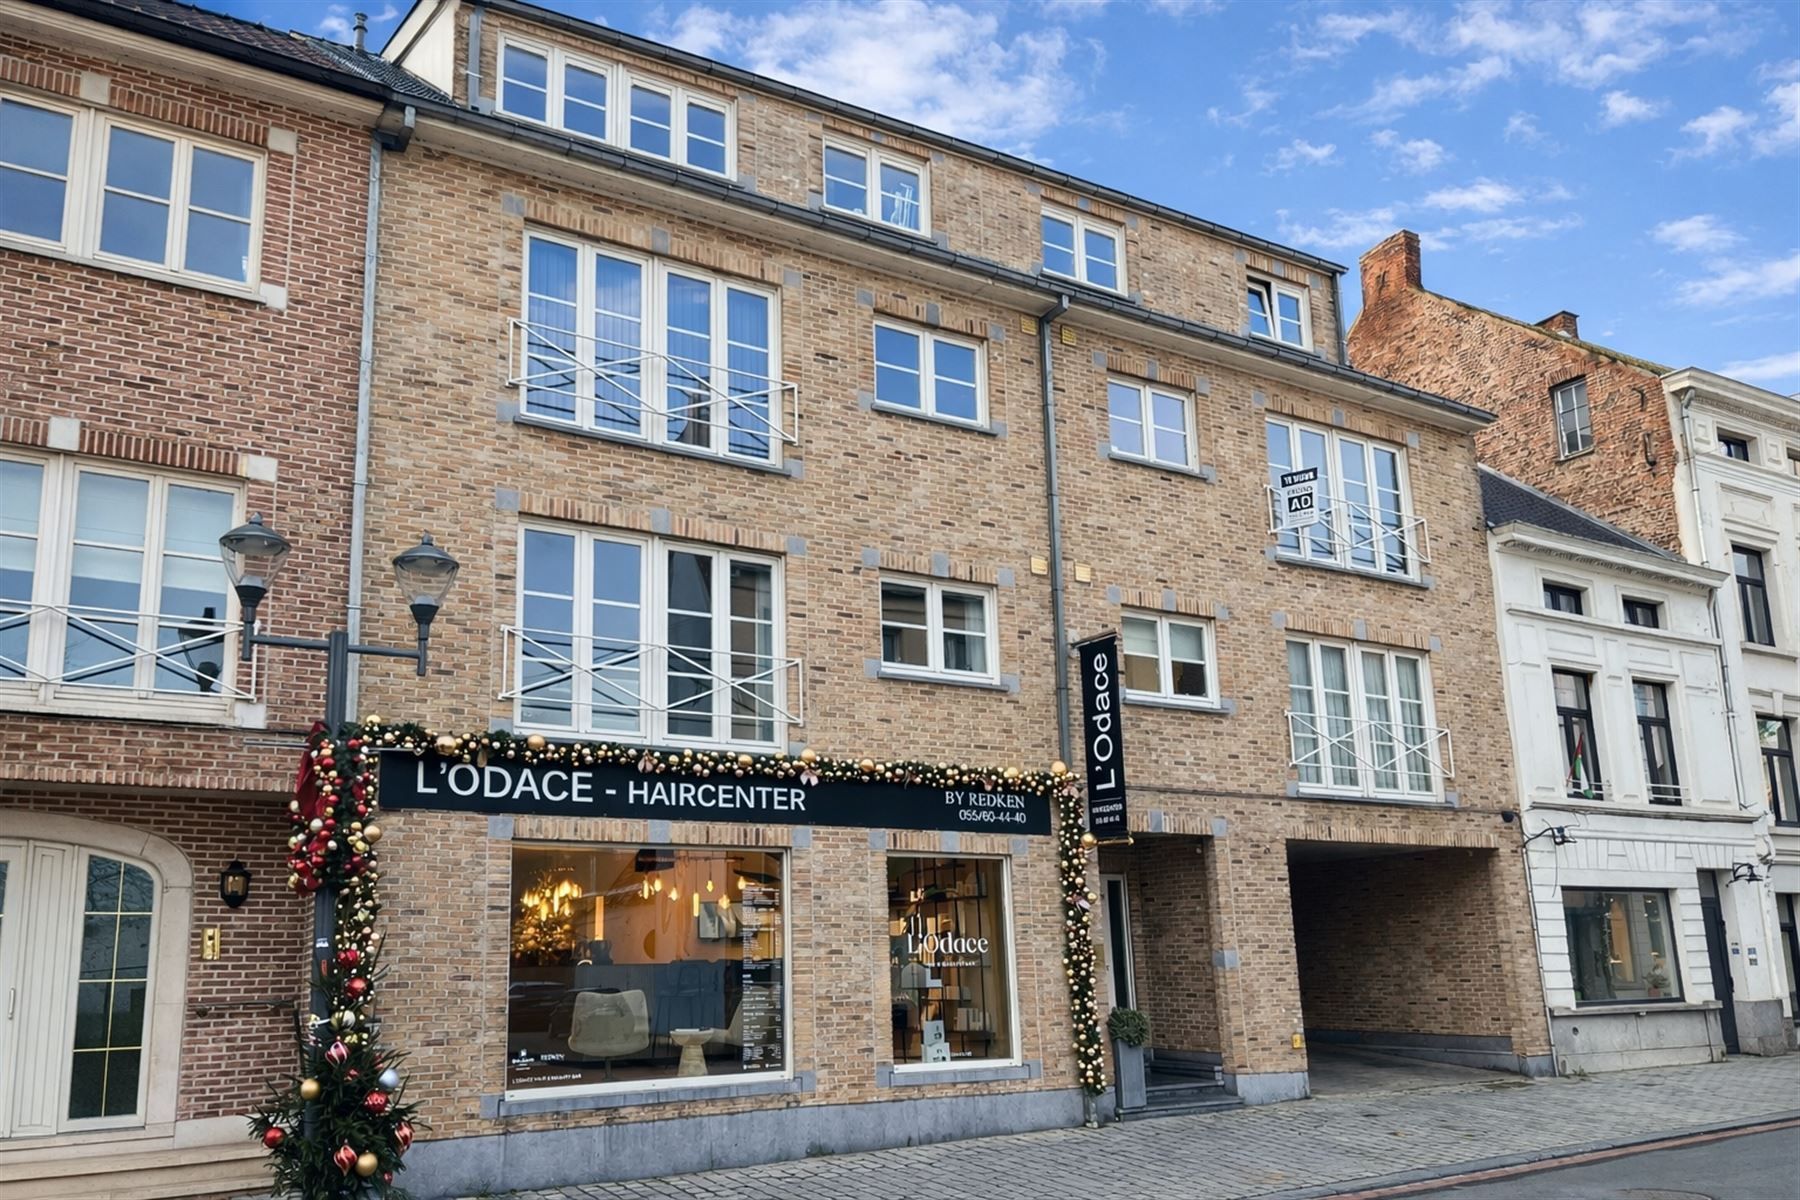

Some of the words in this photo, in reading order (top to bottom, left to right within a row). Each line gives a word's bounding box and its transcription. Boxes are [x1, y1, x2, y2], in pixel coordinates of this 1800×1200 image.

[1092, 652, 1116, 791] L'Odace
[417, 761, 594, 803] L'ODACE
[628, 780, 806, 811] HAIRCENTER
[945, 791, 964, 805] BY
[969, 792, 1025, 809] REDKEN
